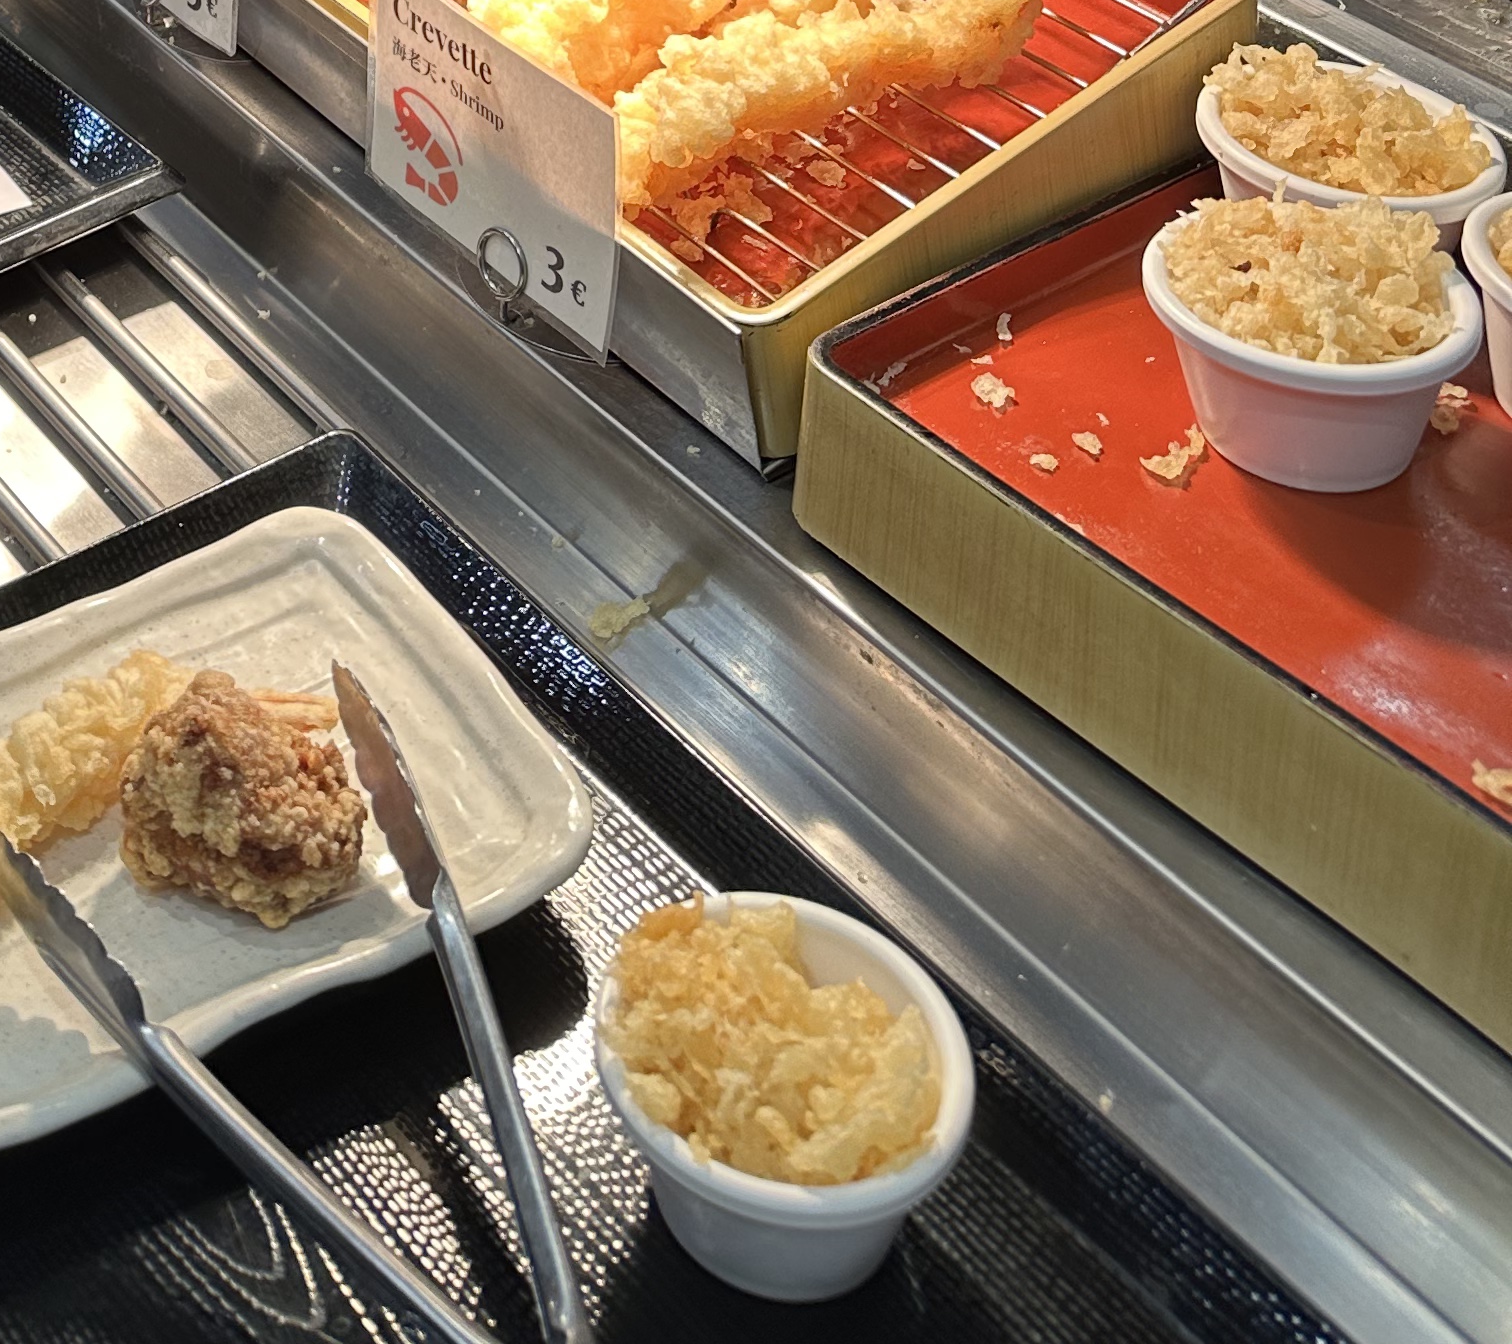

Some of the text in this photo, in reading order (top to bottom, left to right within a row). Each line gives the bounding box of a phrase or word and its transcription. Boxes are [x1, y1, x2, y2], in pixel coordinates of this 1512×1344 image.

[392, 35, 505, 132] 海老天 Shrimp
